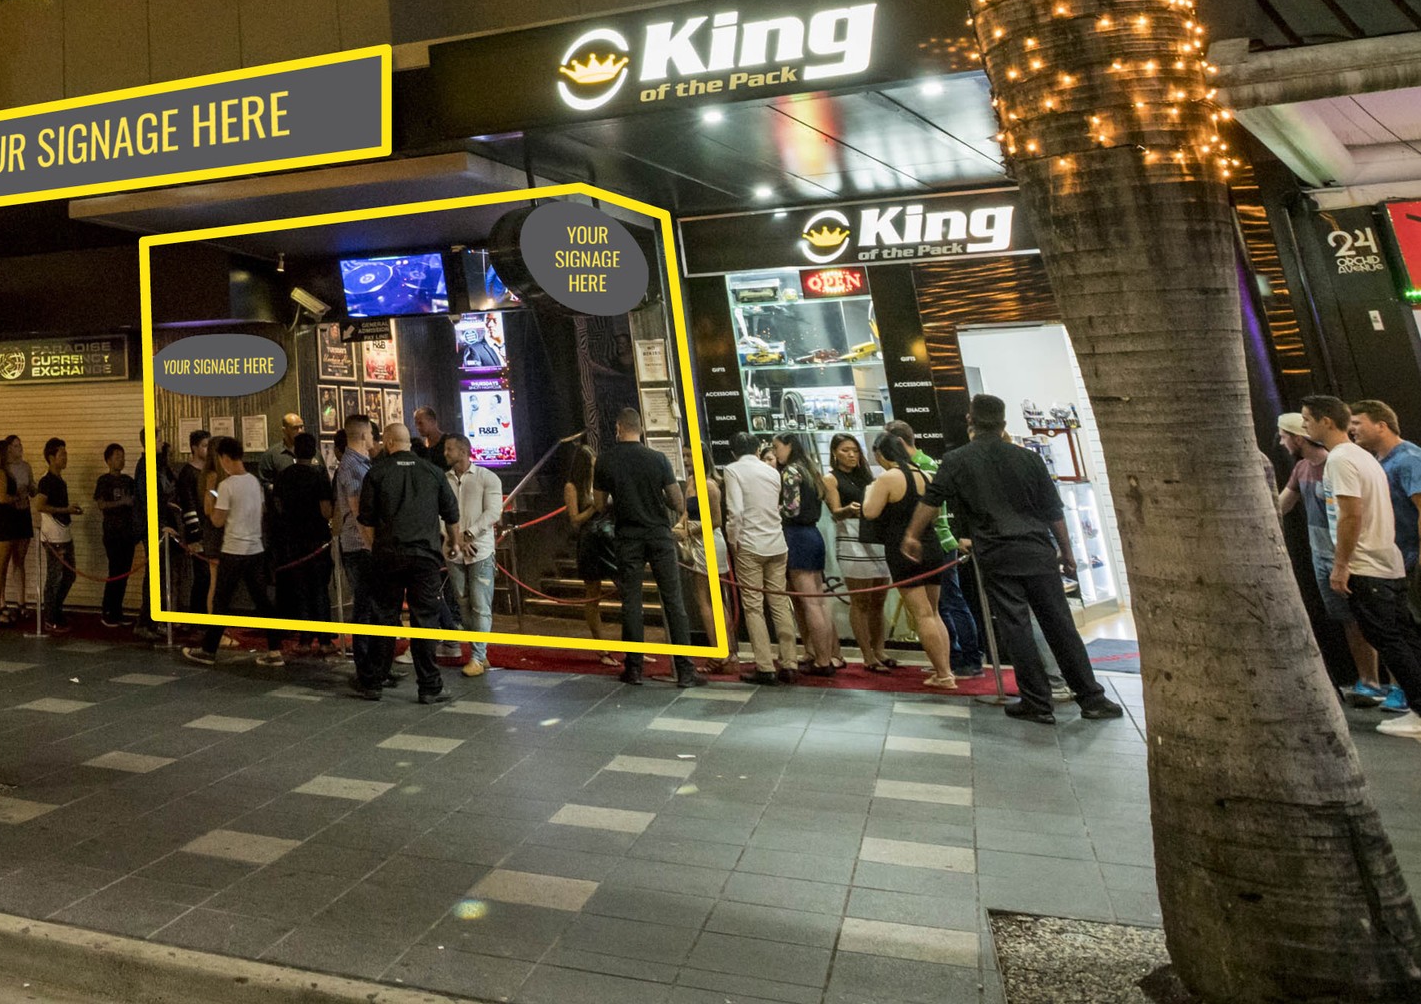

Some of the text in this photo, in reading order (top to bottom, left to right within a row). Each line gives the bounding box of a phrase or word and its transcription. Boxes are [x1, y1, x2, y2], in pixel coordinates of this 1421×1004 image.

[640, 4, 877, 81] King
[640, 66, 798, 102] of the Pack
[858, 205, 1014, 253] King
[858, 243, 963, 260] of the Pack
[1327, 227, 1378, 256] 24
[808, 273, 861, 292] OPEN
[31, 354, 111, 366] CURRENCY
[31, 364, 112, 377] EXCHANGE
